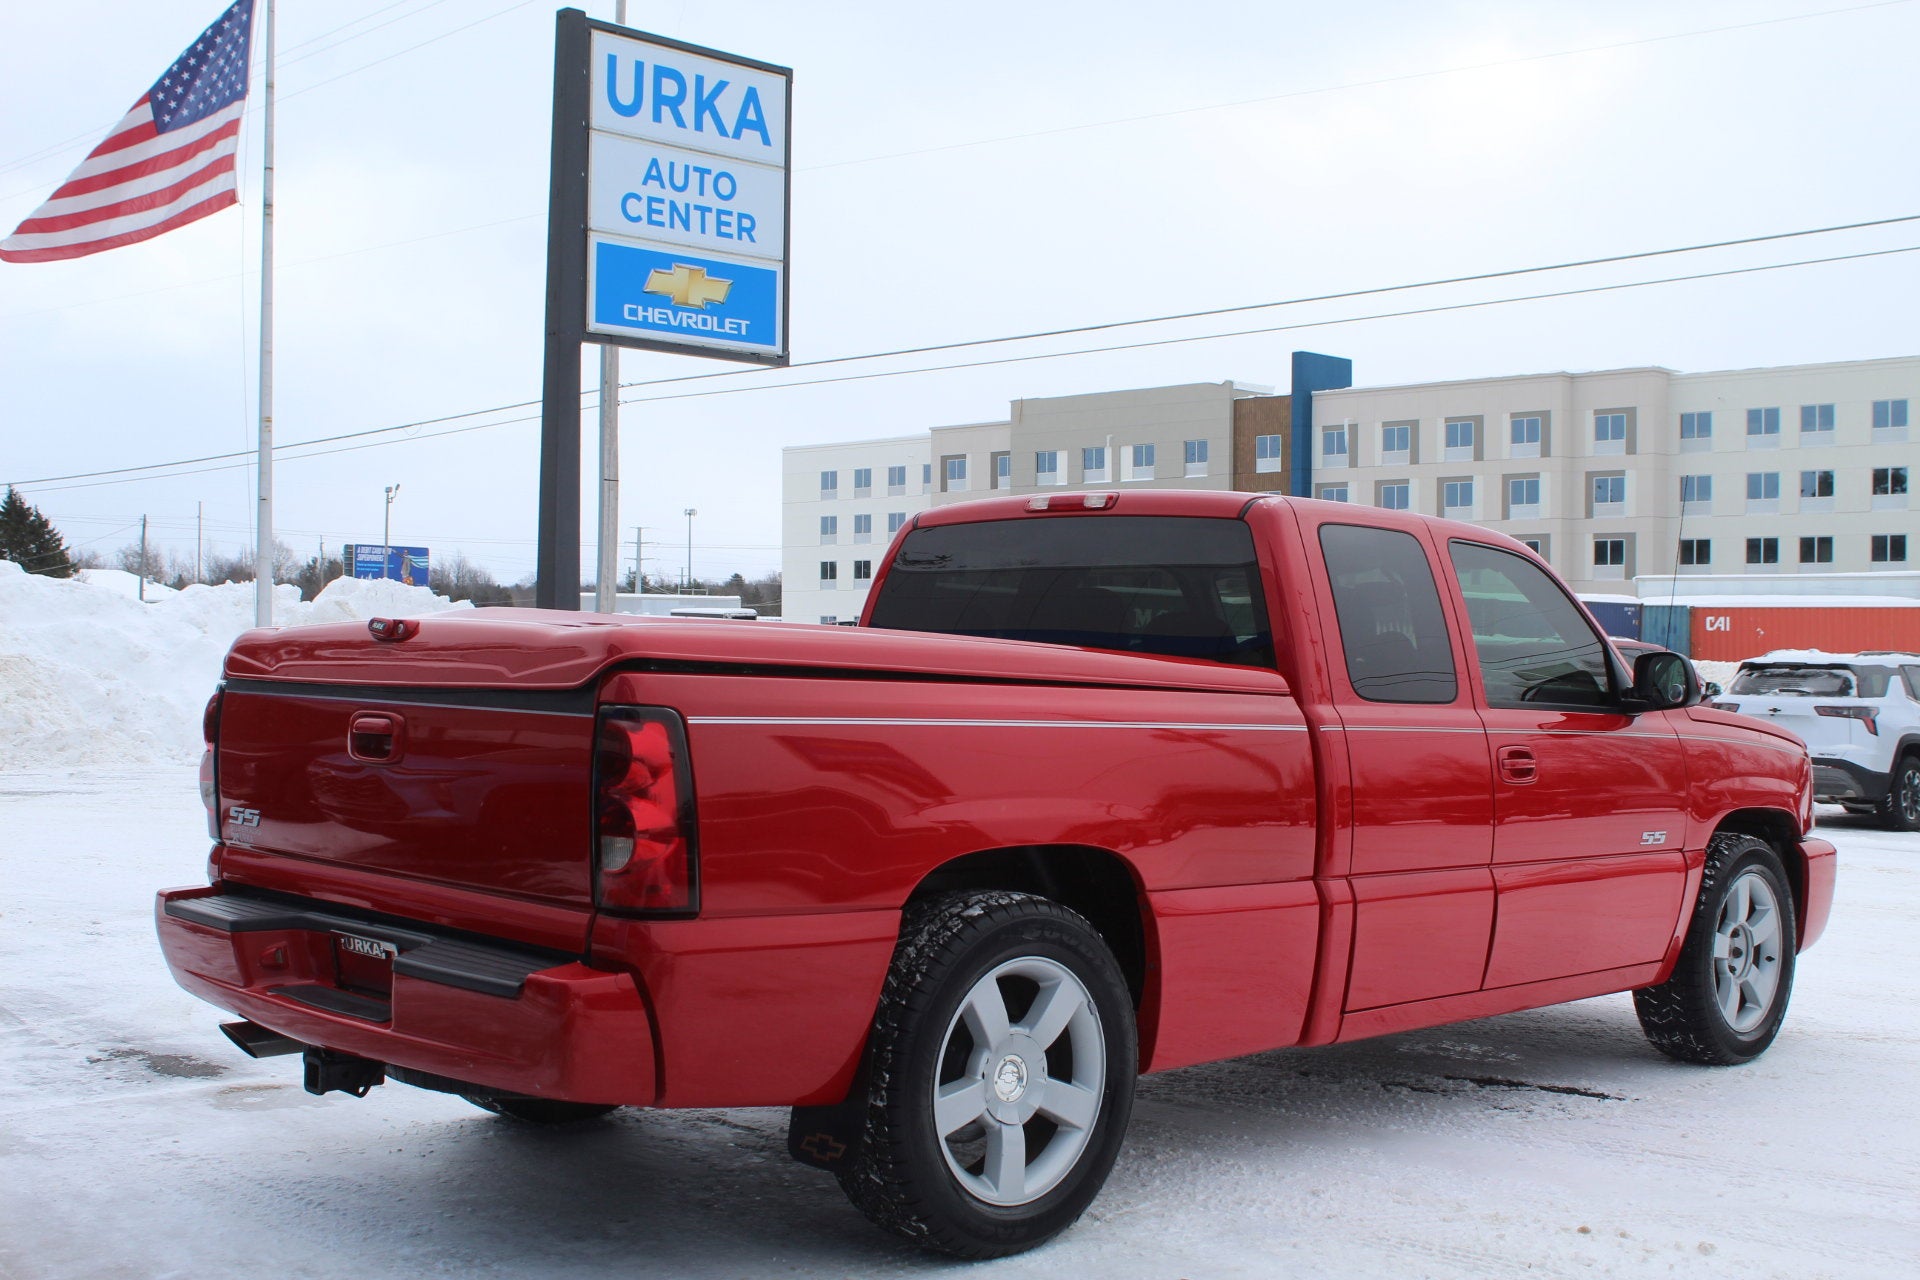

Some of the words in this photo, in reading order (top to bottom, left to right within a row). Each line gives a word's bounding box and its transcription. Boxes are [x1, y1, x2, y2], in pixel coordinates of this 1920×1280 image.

[607, 53, 772, 147] URKA
[642, 157, 737, 201] AUTO
[621, 192, 757, 244] CENTER
[623, 303, 751, 336] CHEVROLET
[1705, 616, 1731, 632] CAI
[229, 806, 260, 827] SS
[1639, 831, 1667, 845] SS
[343, 936, 381, 957] URKA
